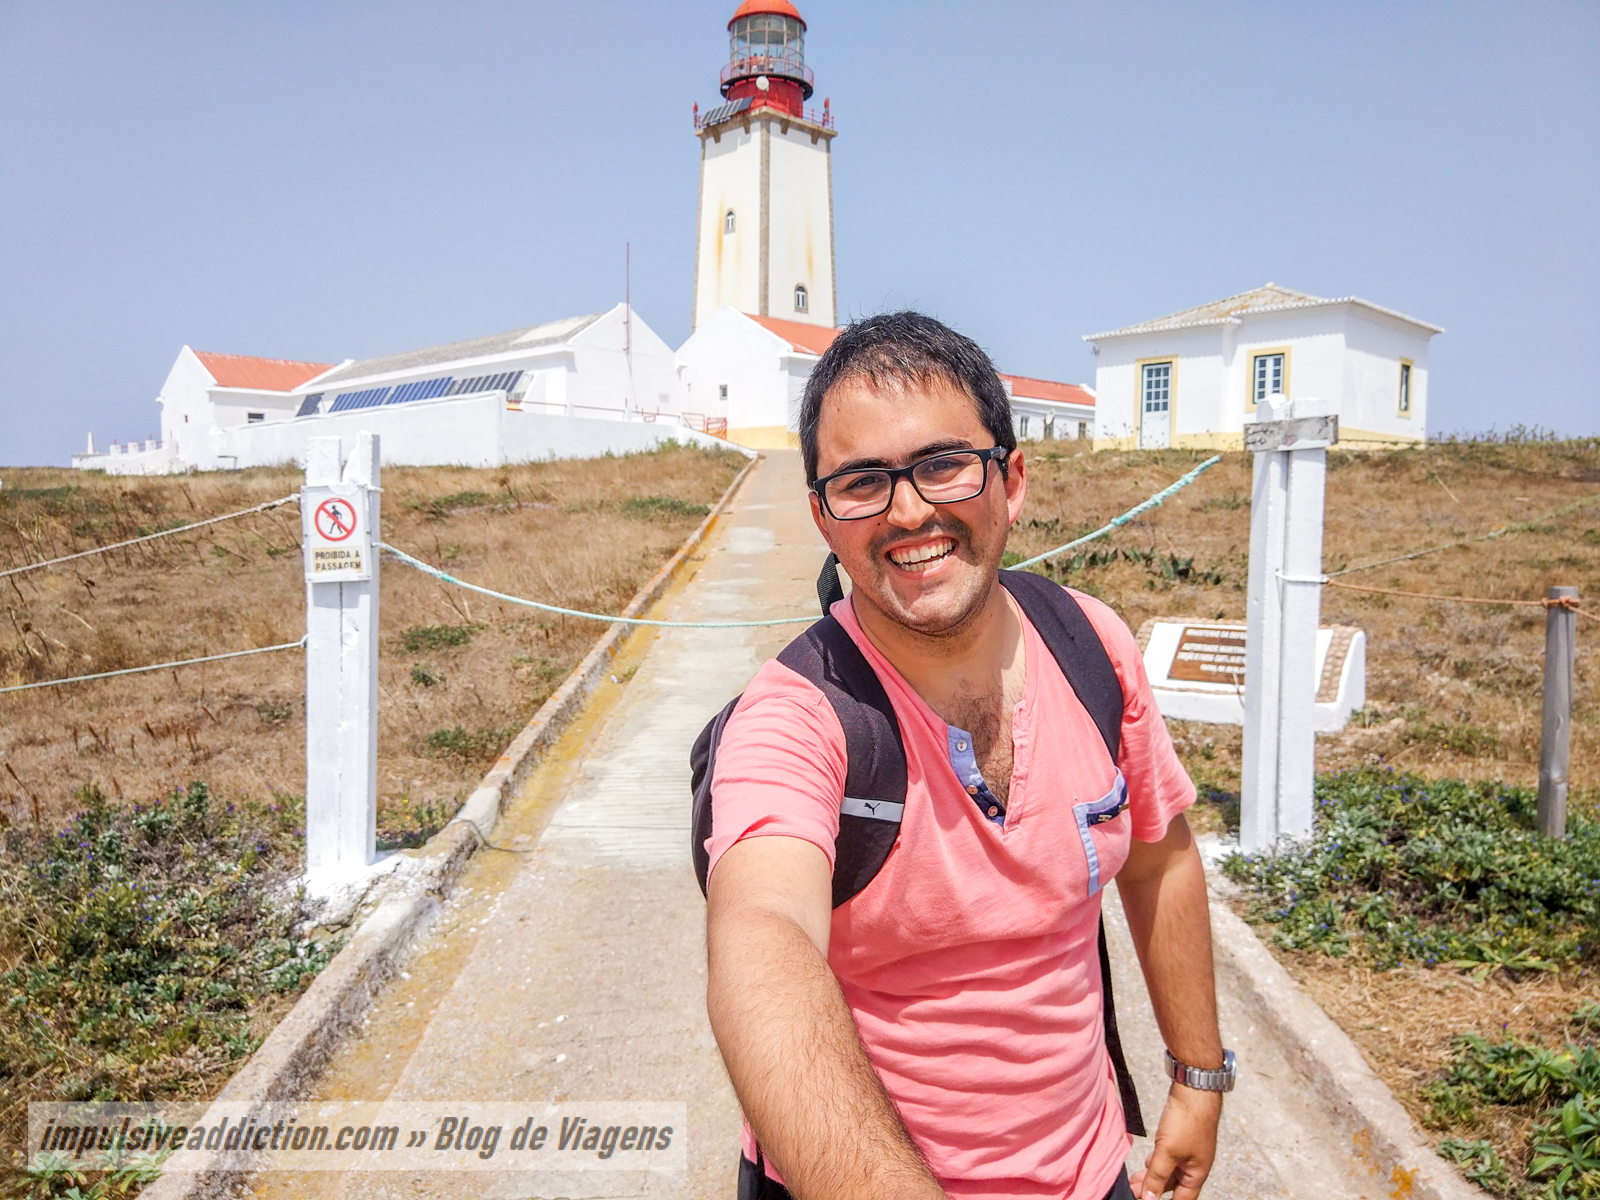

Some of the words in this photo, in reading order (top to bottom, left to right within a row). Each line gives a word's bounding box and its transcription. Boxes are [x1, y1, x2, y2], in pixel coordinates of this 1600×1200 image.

[315, 551, 351, 560] PROIBIDA
[355, 550, 361, 558] A
[316, 561, 362, 571] PASSAGEM
